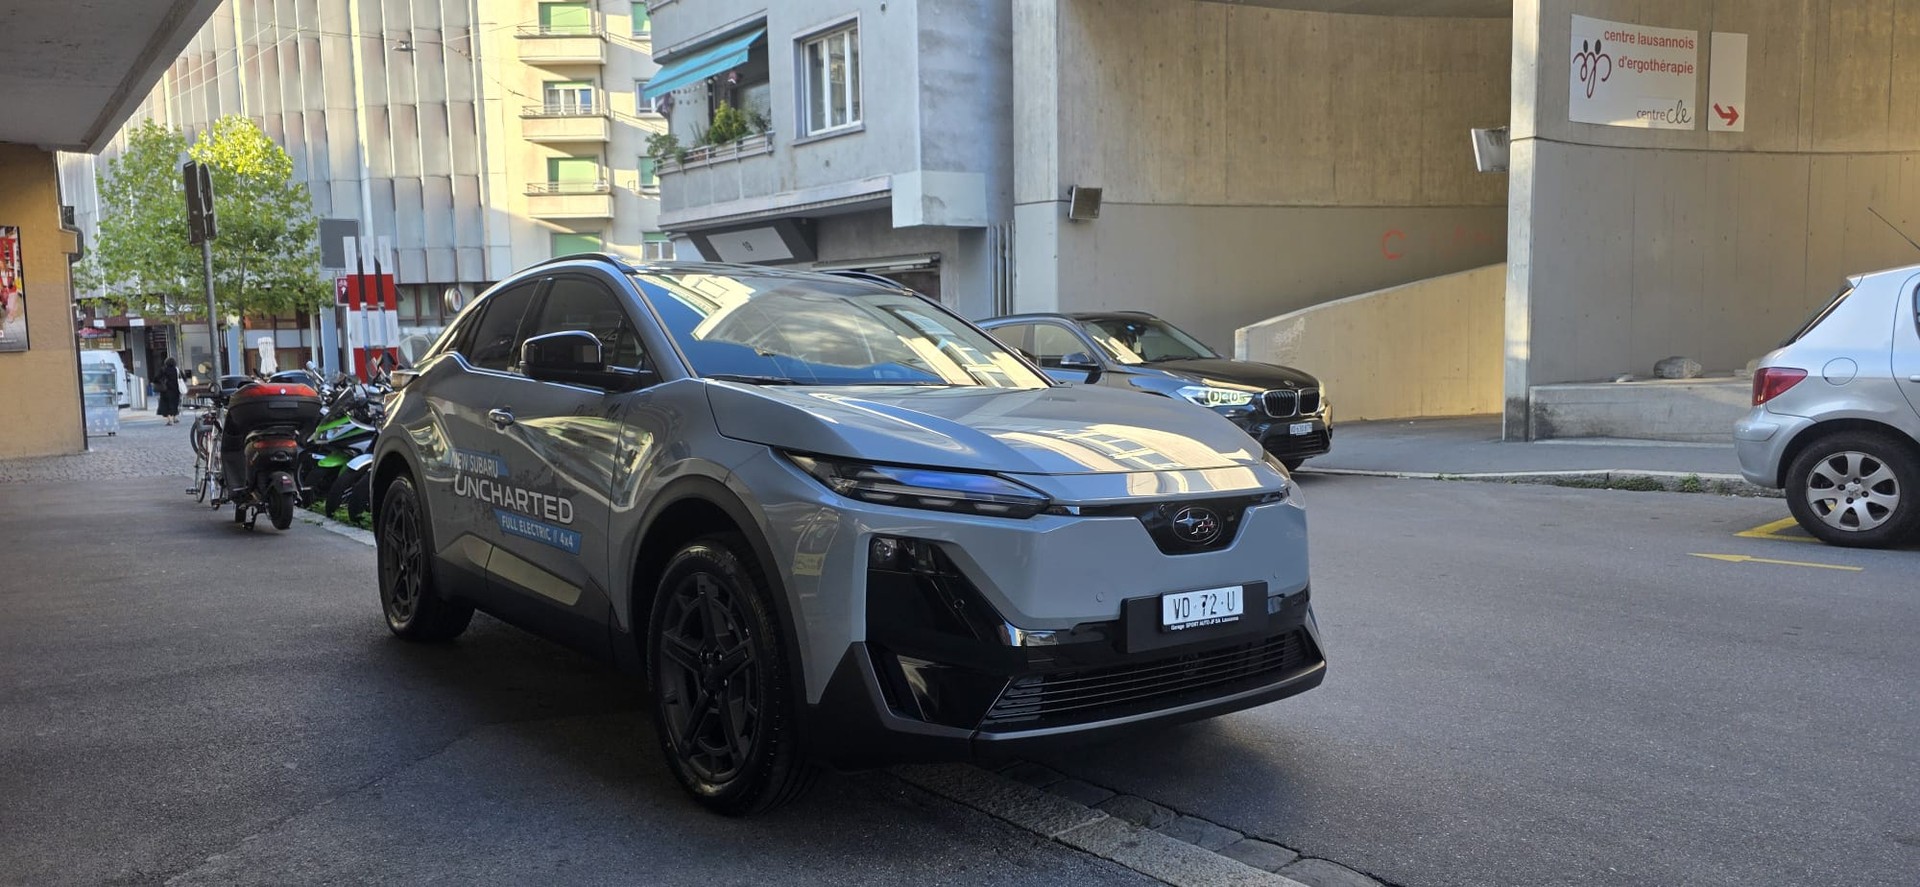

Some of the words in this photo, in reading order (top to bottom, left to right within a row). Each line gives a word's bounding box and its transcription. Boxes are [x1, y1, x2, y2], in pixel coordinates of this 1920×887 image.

[1604, 30, 1635, 44] centre
[1638, 33, 1694, 50] lausannois
[1618, 55, 1694, 77] d'ergothérapie
[1636, 108, 1666, 121] centre
[450, 450, 469, 471] NEW
[469, 454, 499, 479] SUBARU
[454, 472, 574, 524] UNCHARTED
[501, 515, 519, 531] FULL
[519, 520, 552, 541] ELECTRIC
[559, 532, 574, 549] 4x4
[1174, 596, 1190, 620] VD
[1201, 593, 1218, 616] 72
[1227, 590, 1235, 612] U
[1186, 621, 1199, 629] SPORT
